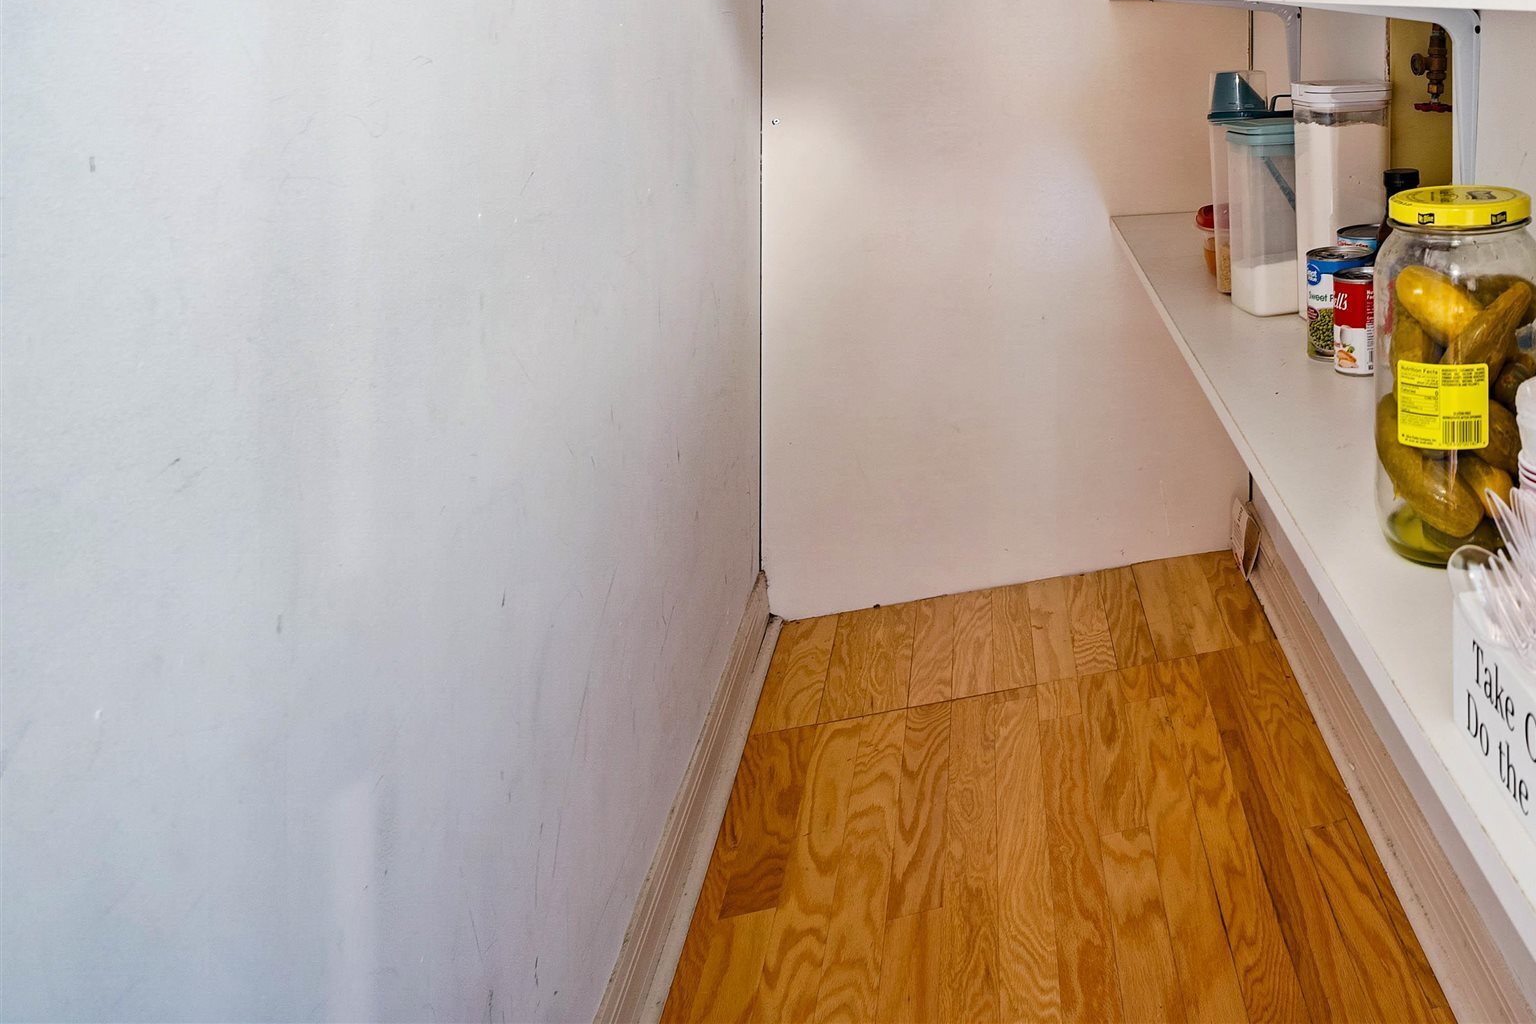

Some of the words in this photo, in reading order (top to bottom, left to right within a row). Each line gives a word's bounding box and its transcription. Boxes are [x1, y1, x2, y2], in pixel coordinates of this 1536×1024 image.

[1471, 638, 1516, 733] Take
[1465, 689, 1490, 758] Do
[1497, 739, 1530, 817] the
